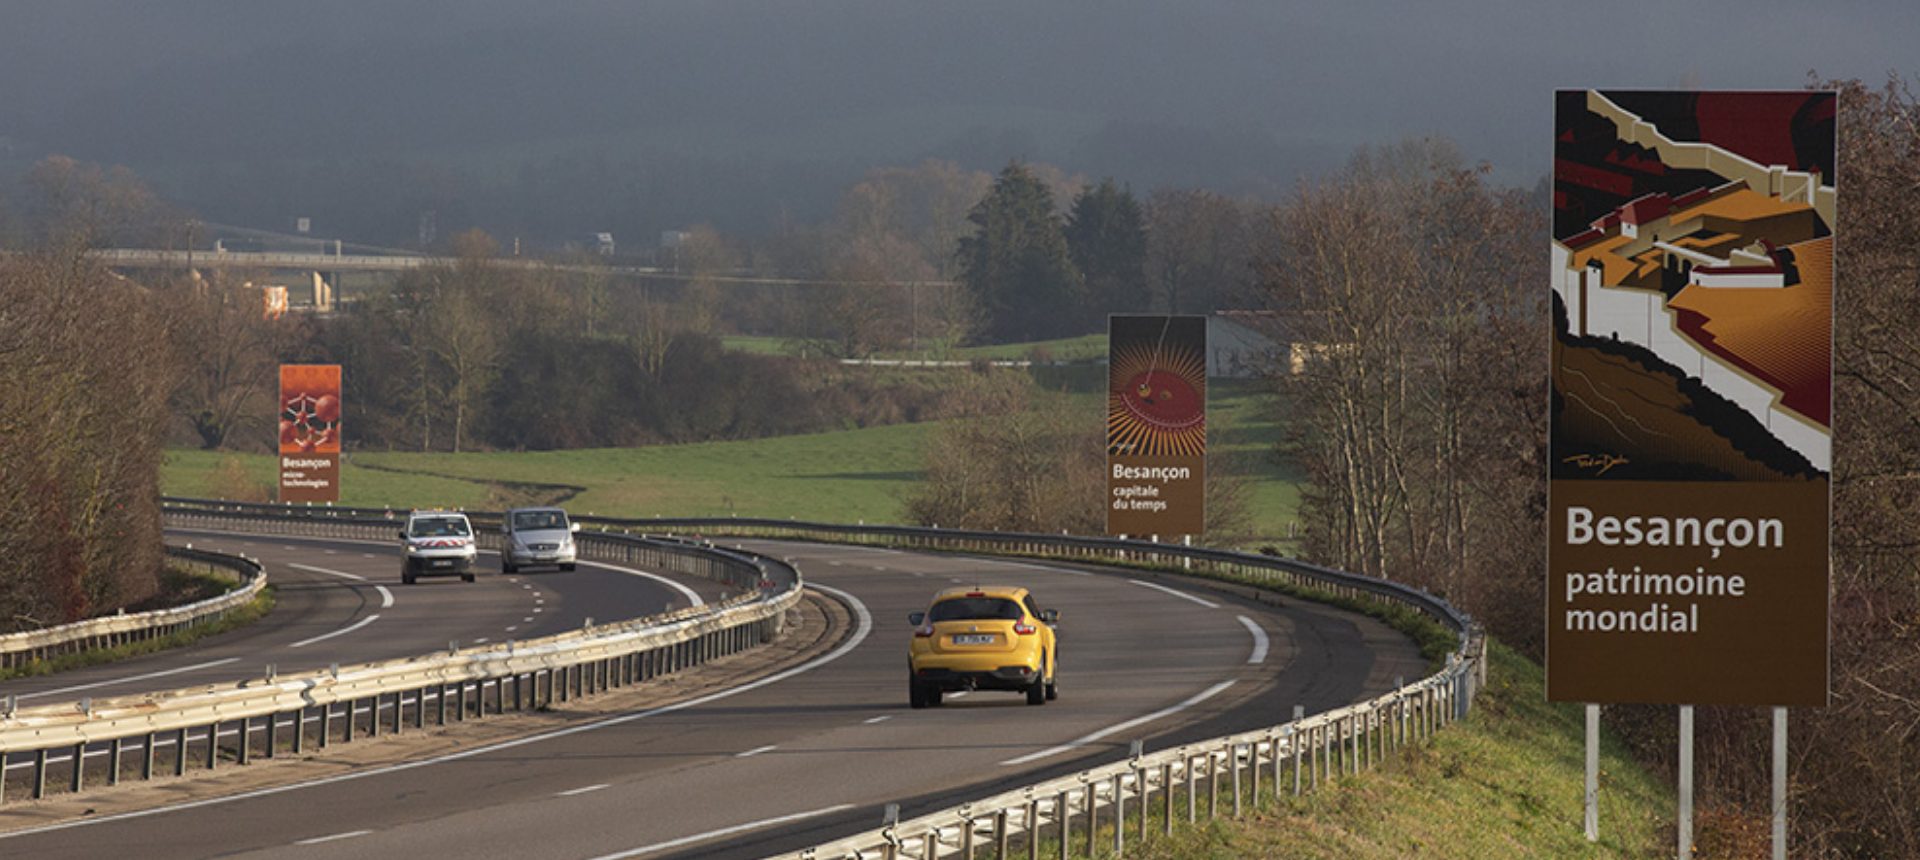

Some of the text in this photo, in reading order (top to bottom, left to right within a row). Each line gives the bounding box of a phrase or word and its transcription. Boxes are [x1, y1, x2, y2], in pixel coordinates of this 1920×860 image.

[283, 458, 331, 470] Besançon
[1113, 464, 1190, 483] Besançon
[1113, 485, 1159, 499] capitale
[1113, 499, 1167, 512] du temps
[1567, 507, 1783, 558] Besançon
[1566, 566, 1745, 602] patrimoine
[1566, 603, 1698, 632] mondial
